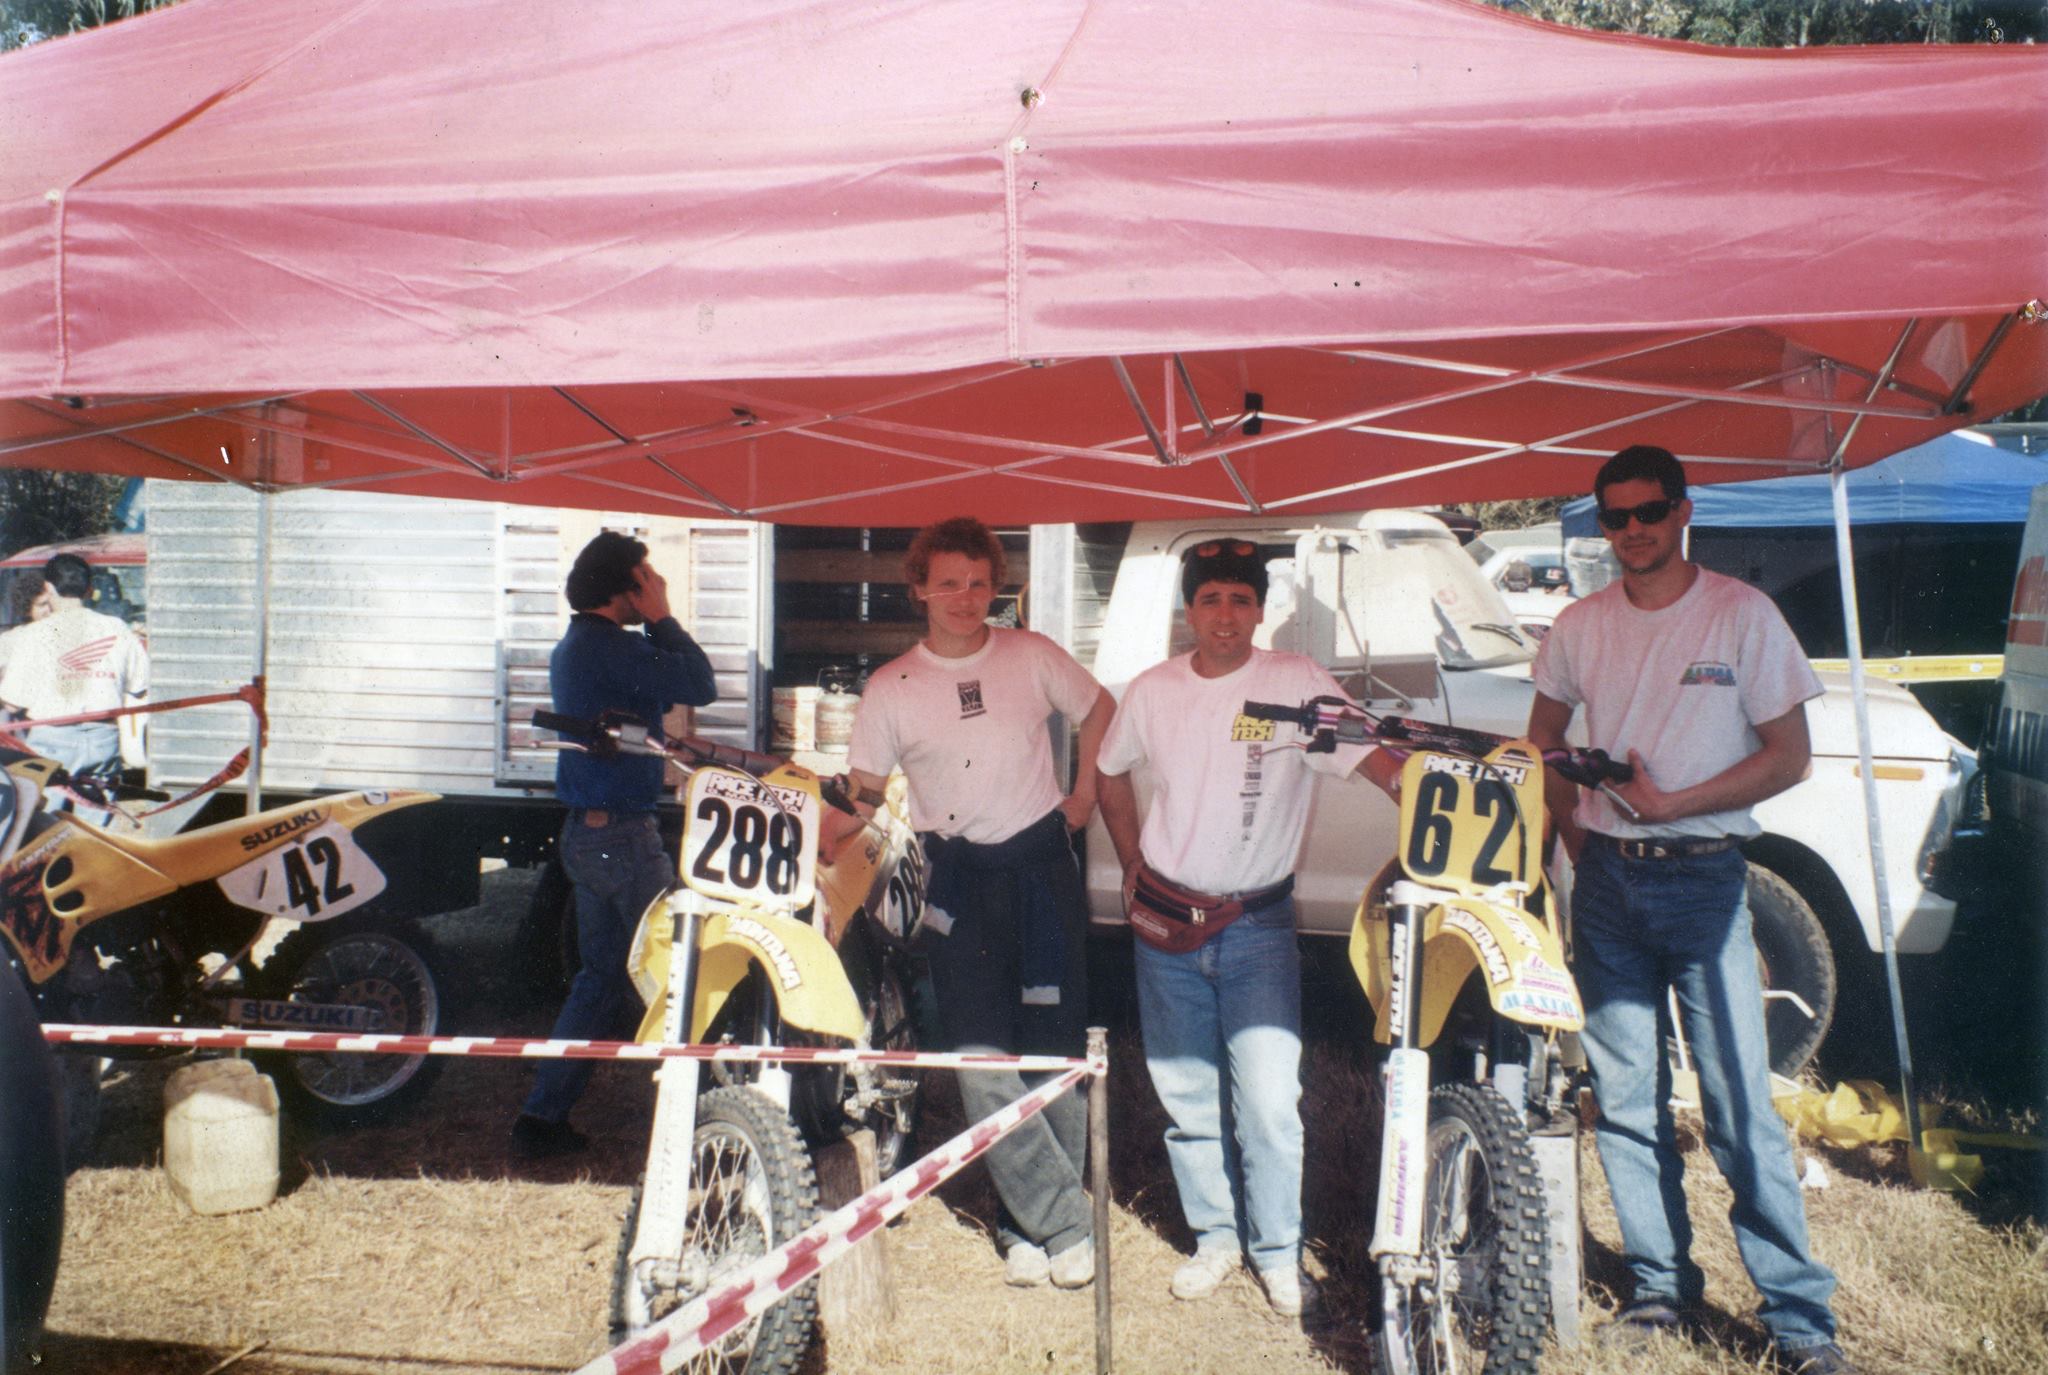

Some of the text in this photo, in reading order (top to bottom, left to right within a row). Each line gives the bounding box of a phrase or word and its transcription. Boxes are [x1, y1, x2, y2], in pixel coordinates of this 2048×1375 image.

[1231, 726, 1276, 741] TECH
[1423, 753, 1476, 777] RACE
[707, 772, 758, 797] RACE
[240, 809, 321, 851] SUZUKI
[1407, 770, 1516, 887] 62
[692, 797, 803, 895] 288
[282, 836, 354, 917] 42
[242, 1002, 355, 1026] SUZUKI
